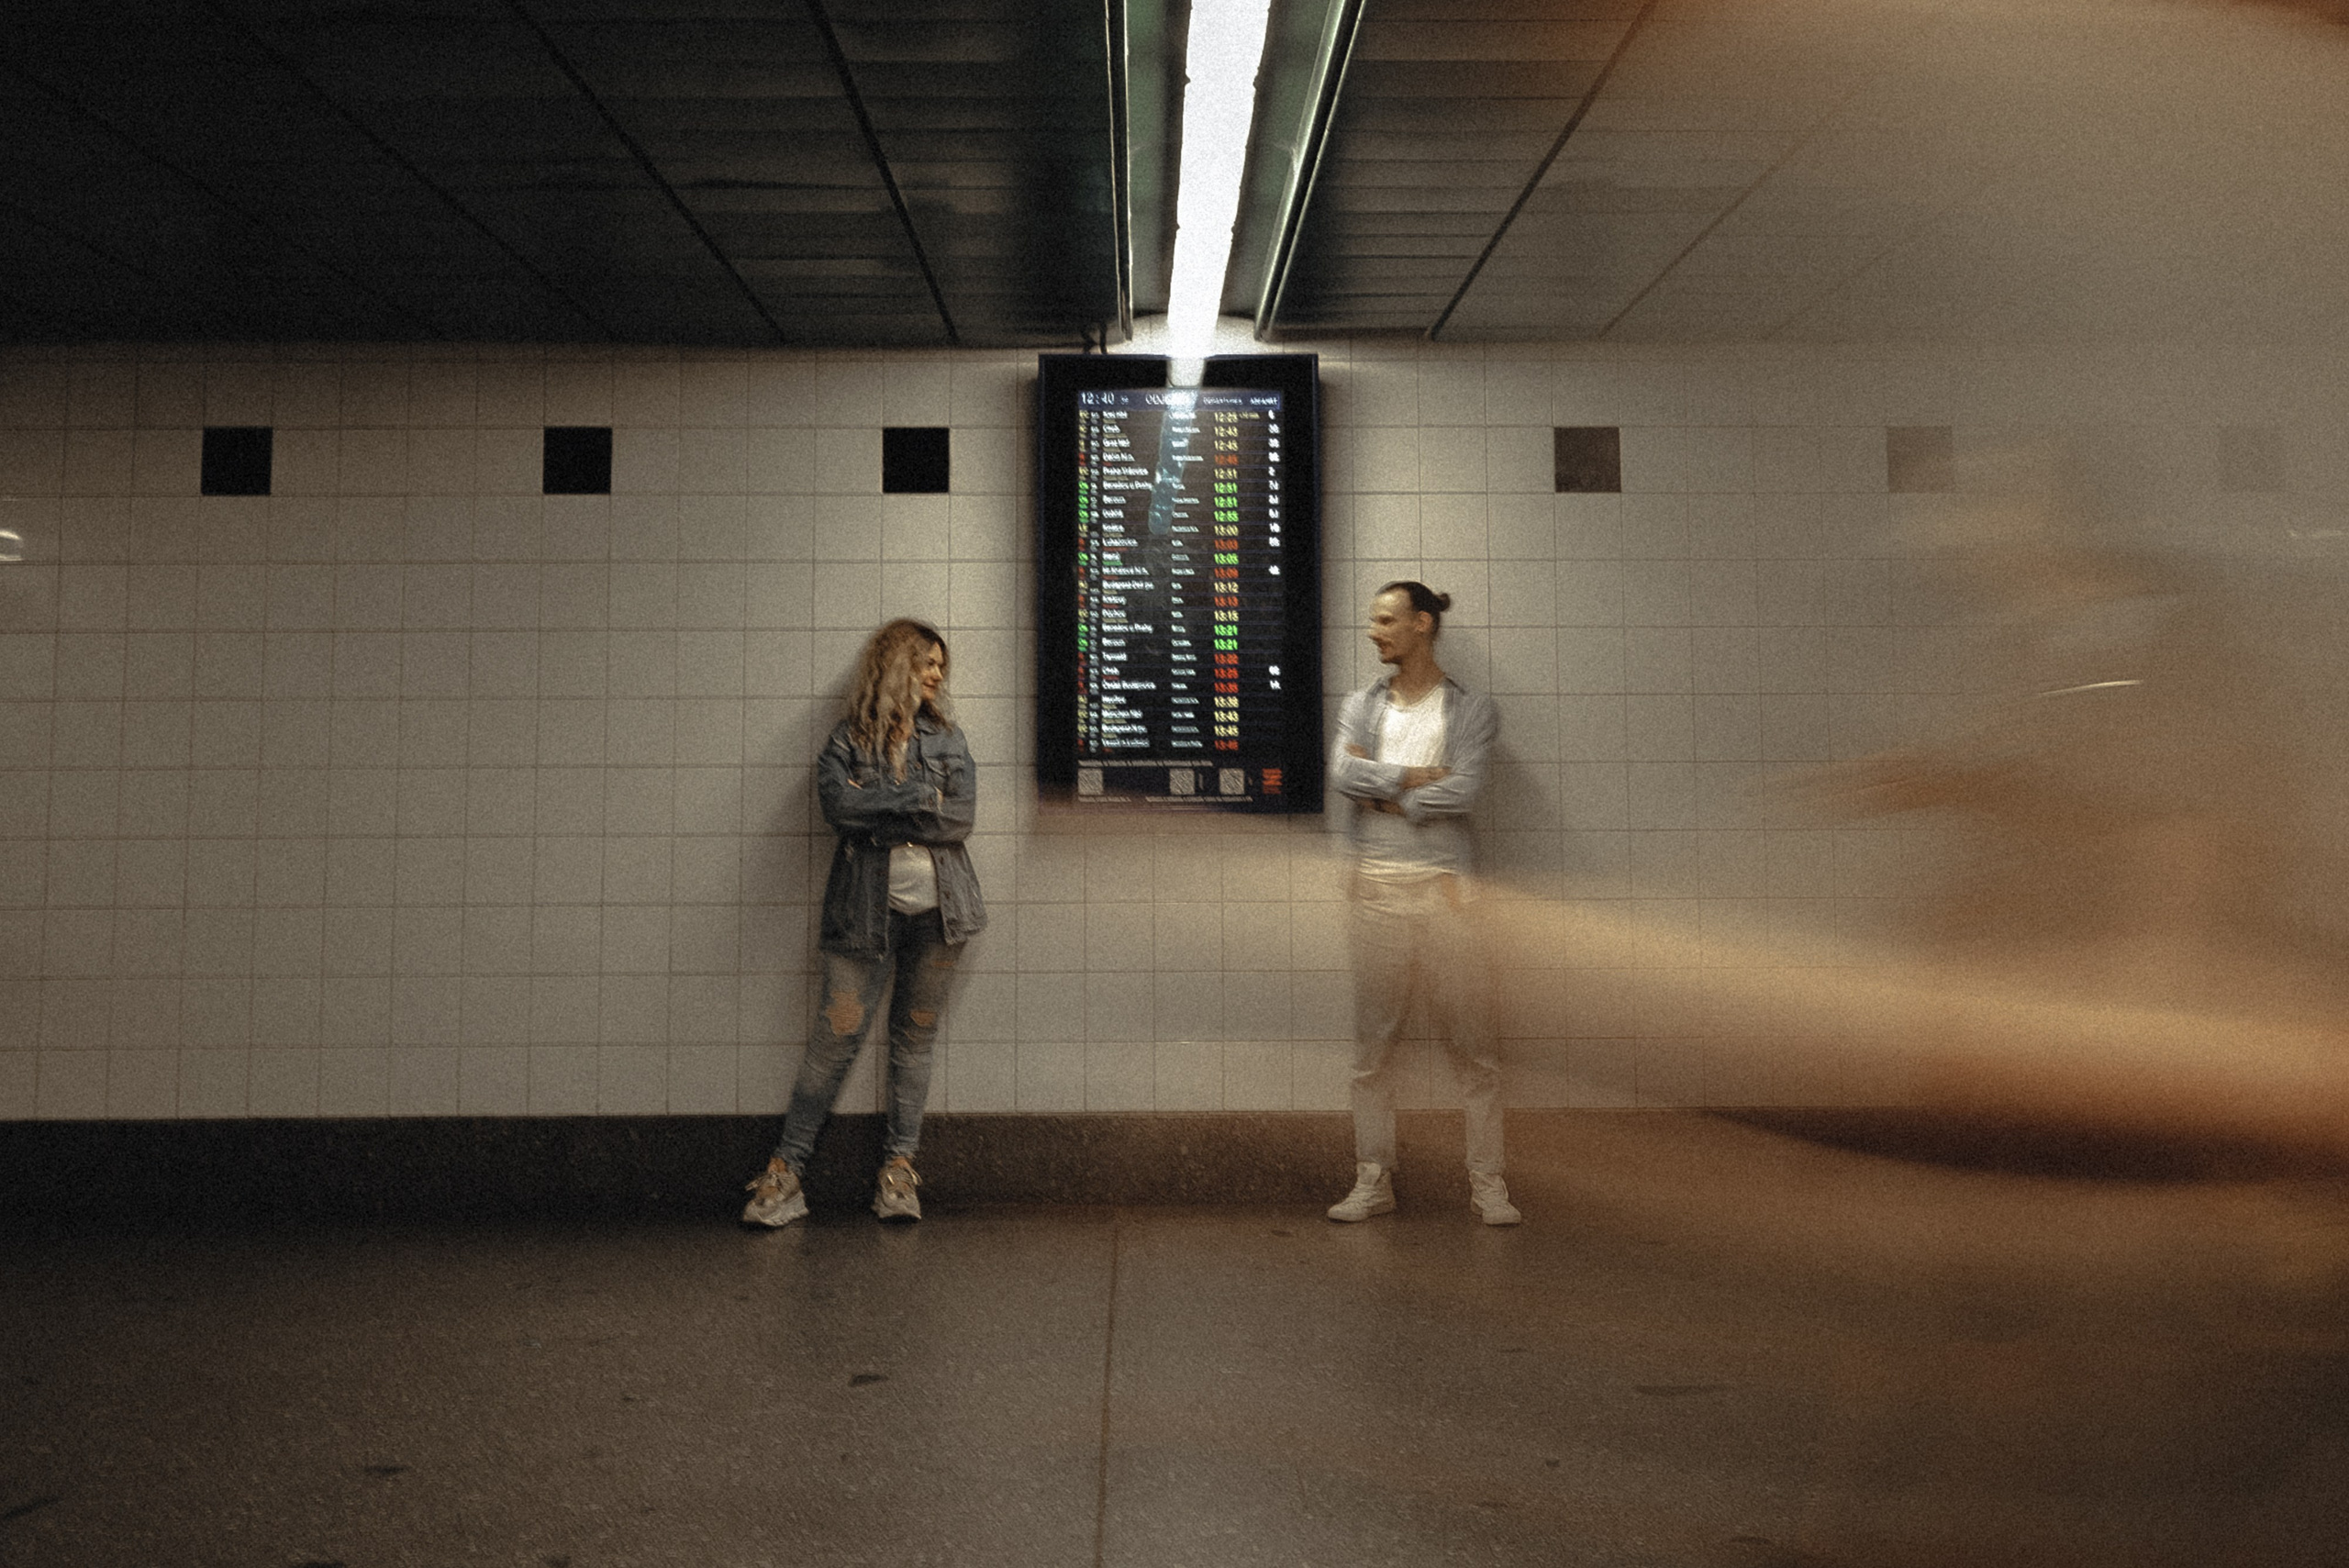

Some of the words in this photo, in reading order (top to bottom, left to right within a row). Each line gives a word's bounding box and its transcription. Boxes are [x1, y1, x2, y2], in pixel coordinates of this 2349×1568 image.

[1080, 392, 1115, 405] 12:40
[1214, 526, 1239, 537] 13:00
[1214, 583, 1239, 594] 13:12
[1214, 626, 1239, 637] 13:21
[1214, 640, 1239, 651] 13:21
